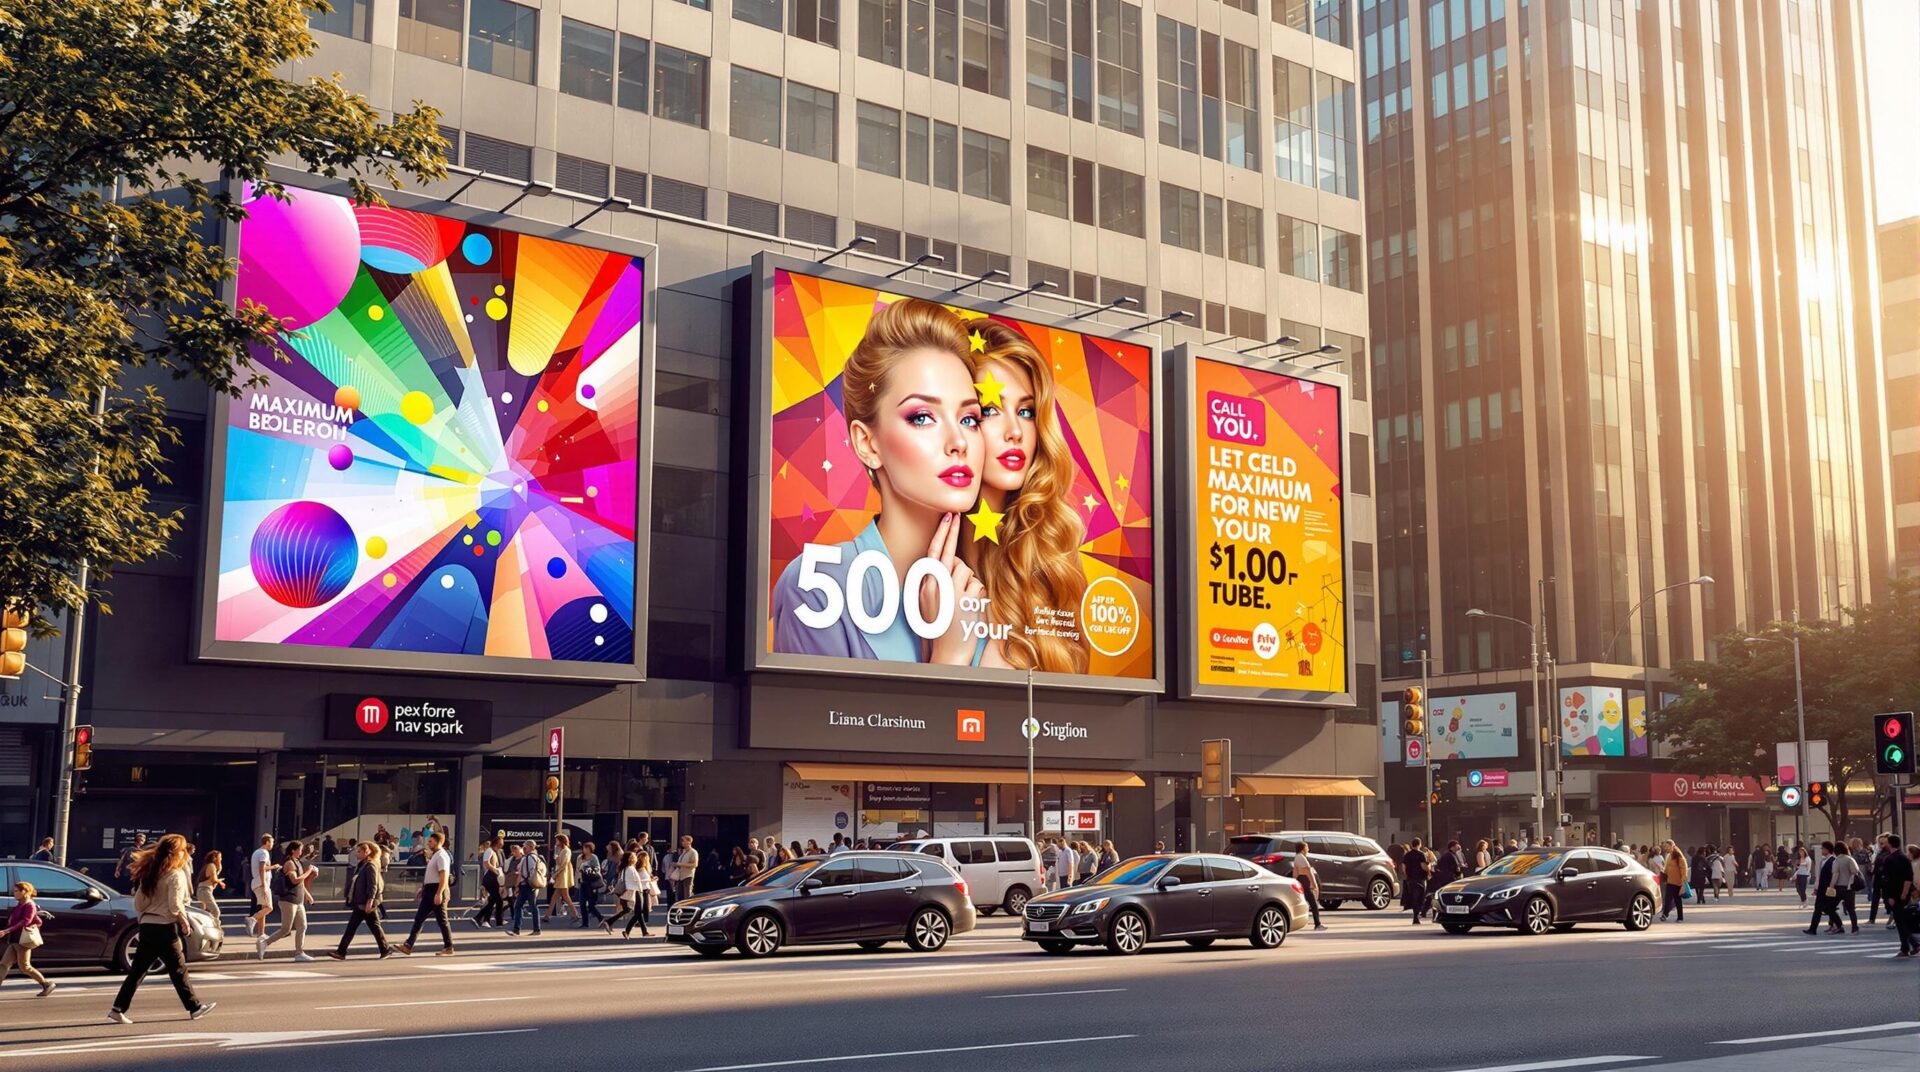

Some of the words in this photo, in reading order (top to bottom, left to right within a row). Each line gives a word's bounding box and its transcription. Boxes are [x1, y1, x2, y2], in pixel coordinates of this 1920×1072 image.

[249, 393, 354, 424] MAXIMUM
[1211, 399, 1246, 417] CALL
[1210, 446, 1243, 470] LET
[1247, 452, 1297, 477] CELD
[1208, 469, 1312, 503] MAXIMUM
[1210, 492, 1250, 517] FOR
[1254, 499, 1300, 523] NEW
[1212, 516, 1272, 544] YOUR
[793, 543, 955, 640] 500
[1209, 581, 1271, 610] TUBE.
[1089, 604, 1132, 623] 100%
[960, 620, 1013, 642] your
[395, 705, 421, 719] pex
[422, 703, 456, 718] forre
[395, 720, 421, 733] nav
[424, 720, 464, 737] spark
